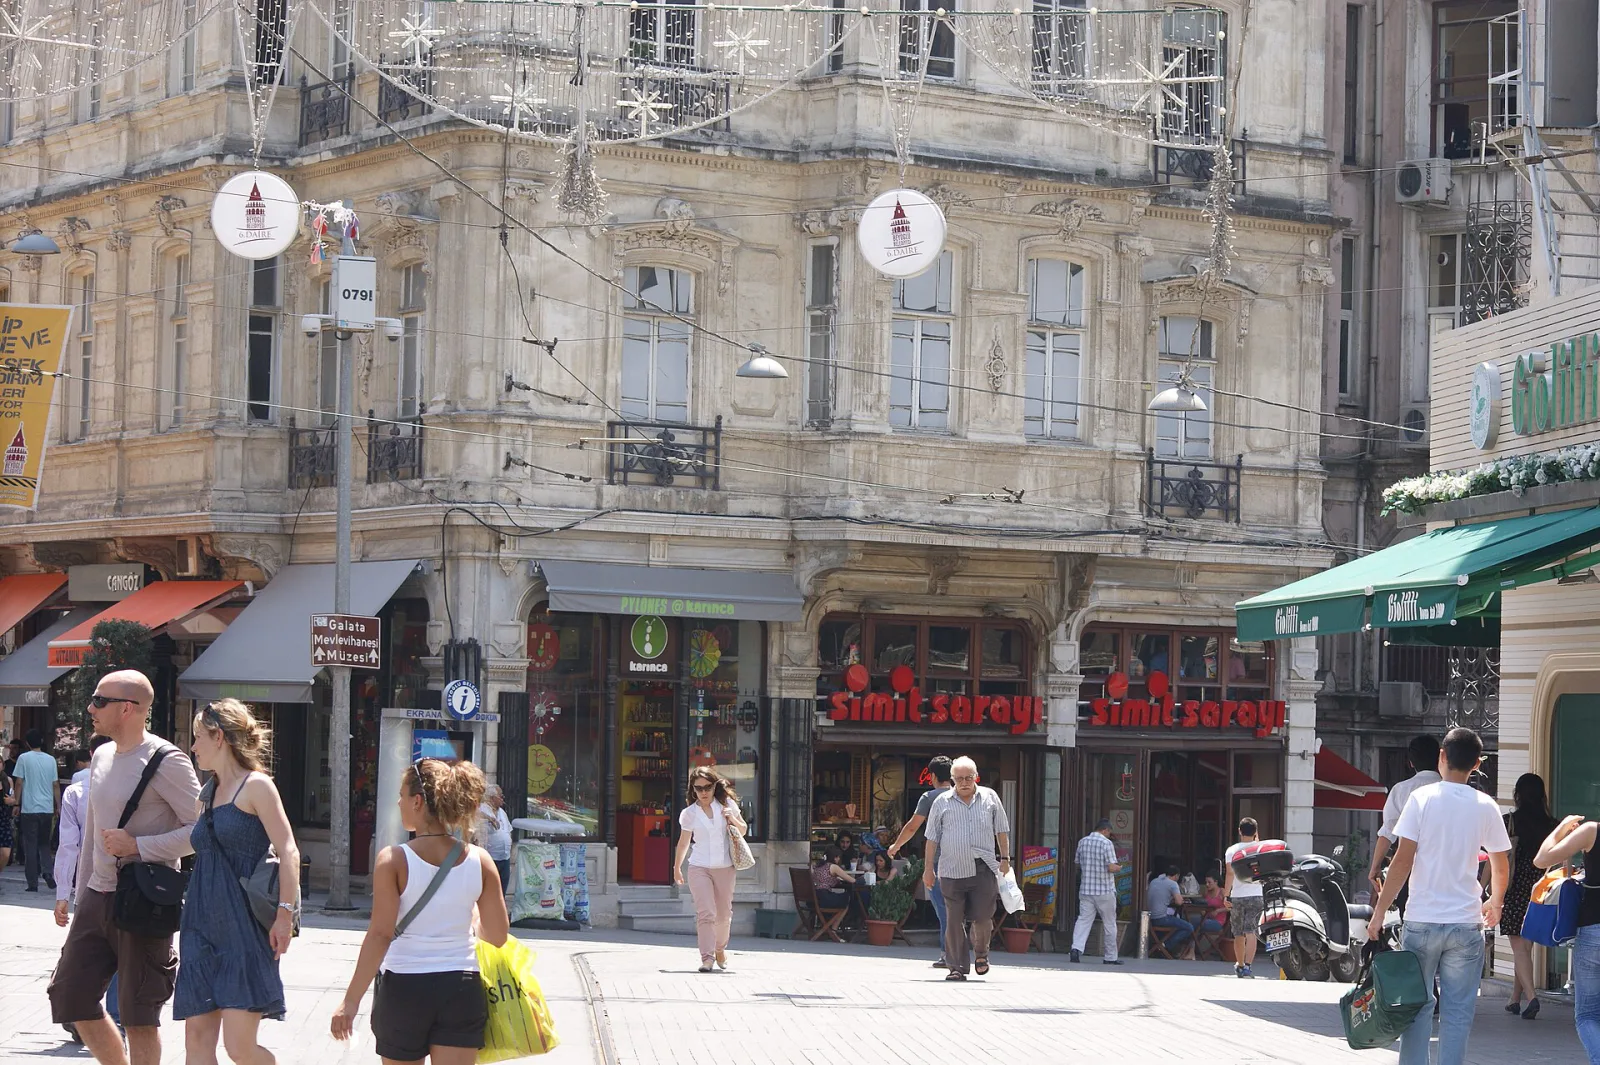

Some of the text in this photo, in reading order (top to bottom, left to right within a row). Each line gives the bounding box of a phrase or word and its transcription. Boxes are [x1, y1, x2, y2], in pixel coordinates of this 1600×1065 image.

[21, 328, 51, 350] VE
[107, 571, 140, 592] CANGÖZ
[620, 596, 668, 614] PYLONES
[671, 600, 684, 615] @
[1388, 590, 1419, 622] Giolitti
[328, 619, 366, 632] Galata
[314, 634, 379, 648] Mevlevihanesi
[326, 650, 368, 663] Müzesi
[826, 664, 923, 723] simit
[1089, 671, 1174, 726] simit
[406, 710, 442, 718] EKRANA
